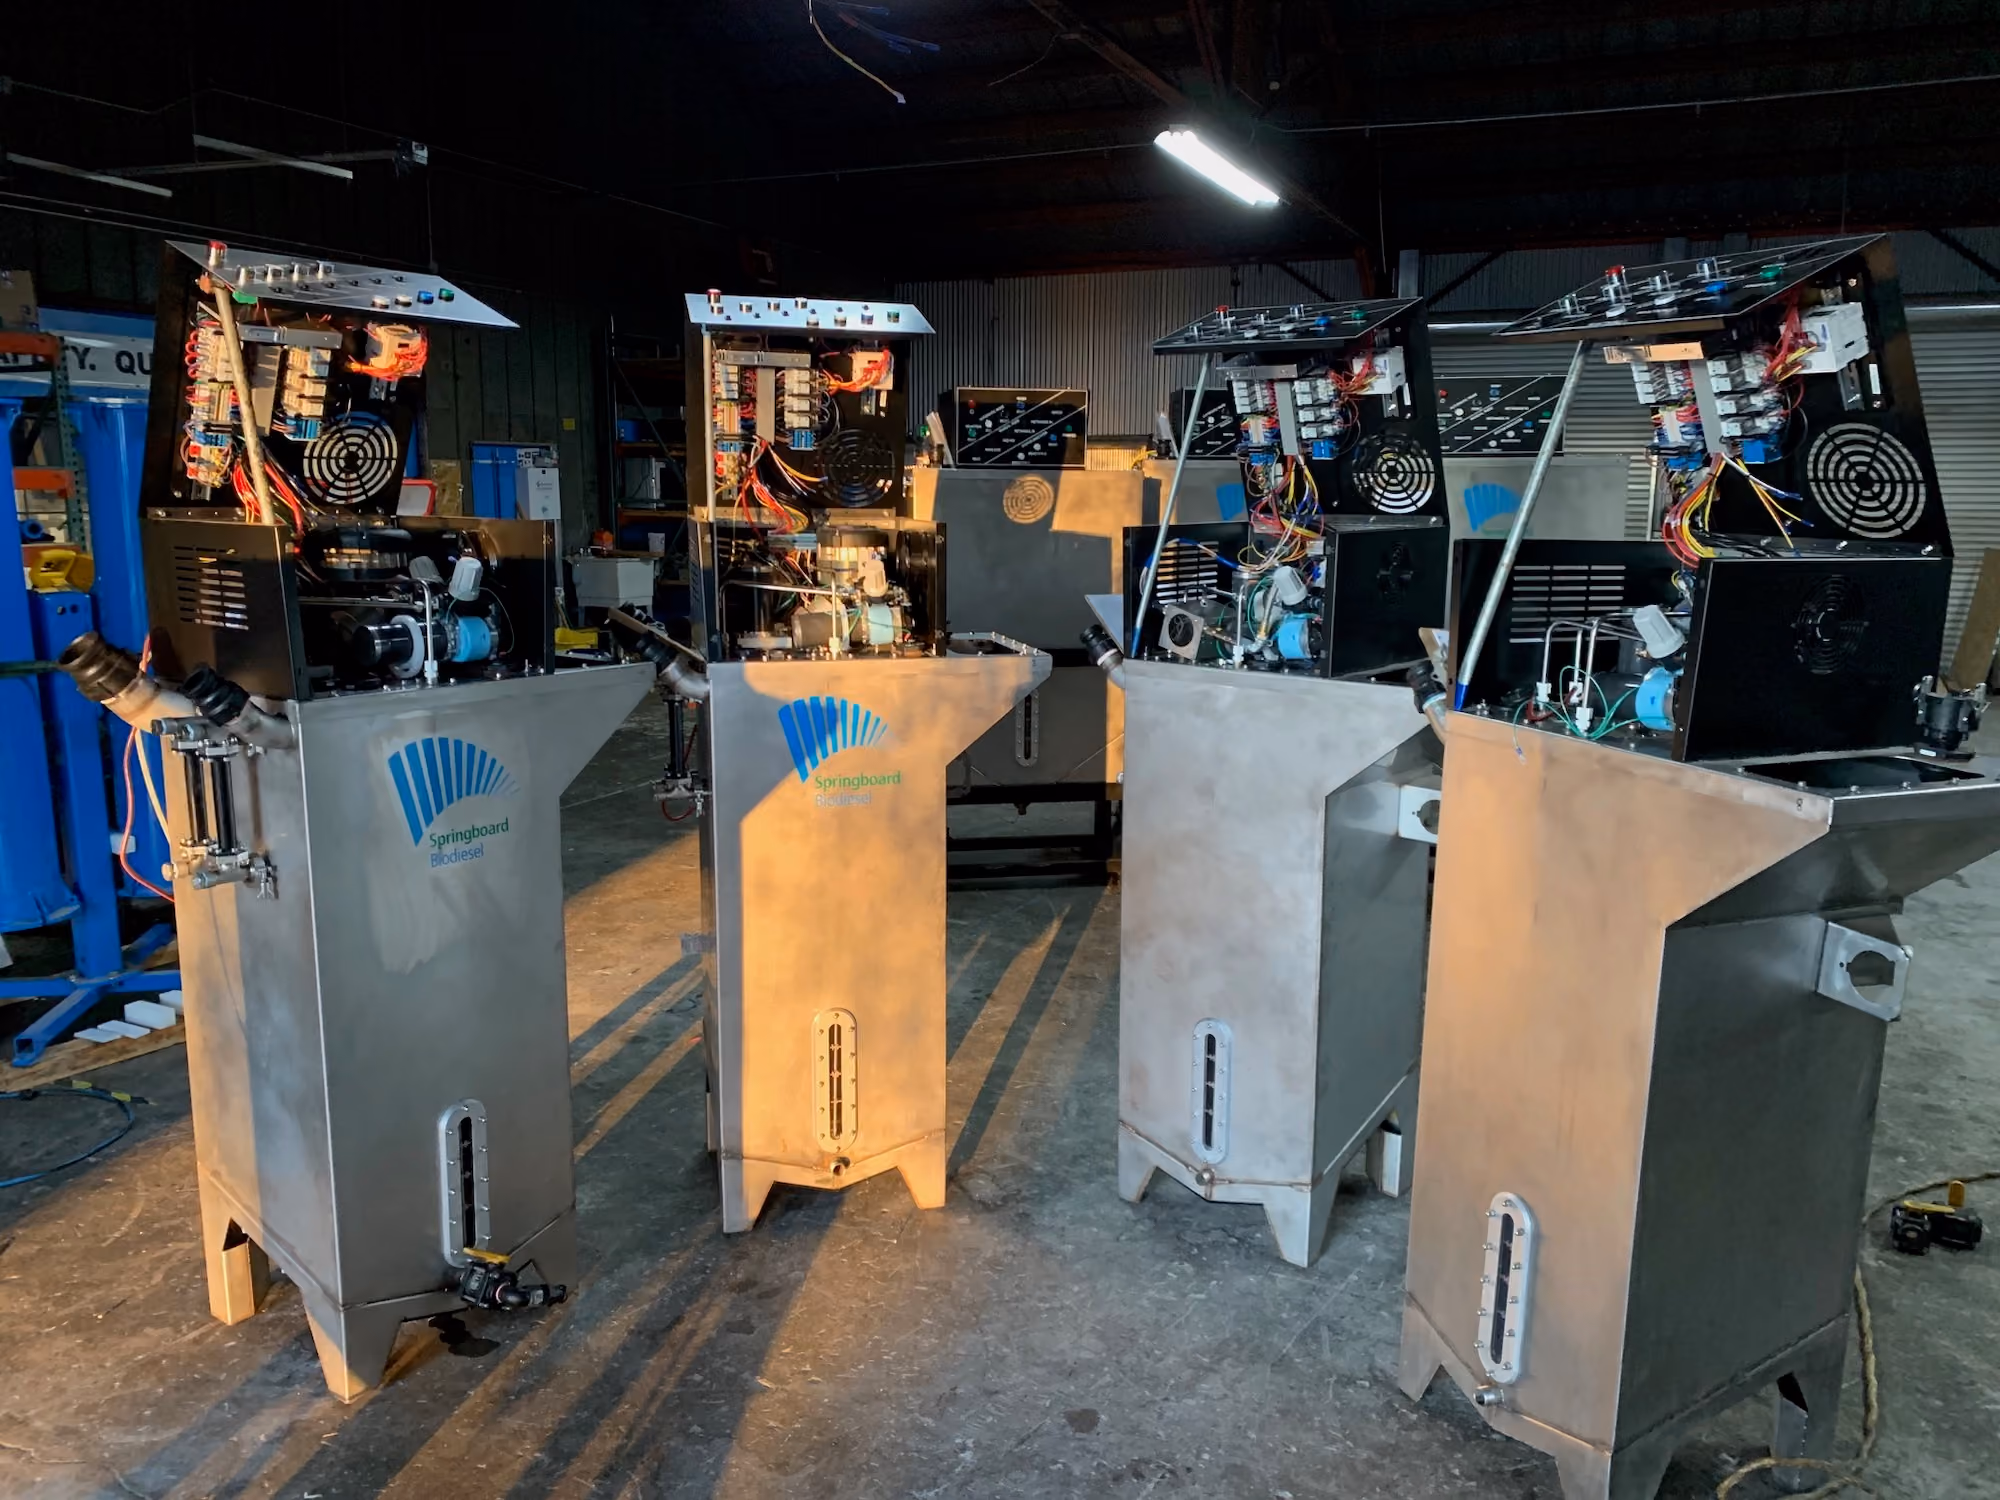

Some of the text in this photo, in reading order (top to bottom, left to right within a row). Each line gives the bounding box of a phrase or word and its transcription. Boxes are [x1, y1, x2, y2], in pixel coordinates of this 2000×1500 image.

[115, 350, 151, 376] QU
[815, 771, 901, 791] Springboard
[429, 817, 509, 849] Springboard
[430, 843, 485, 868] Biodiesel
